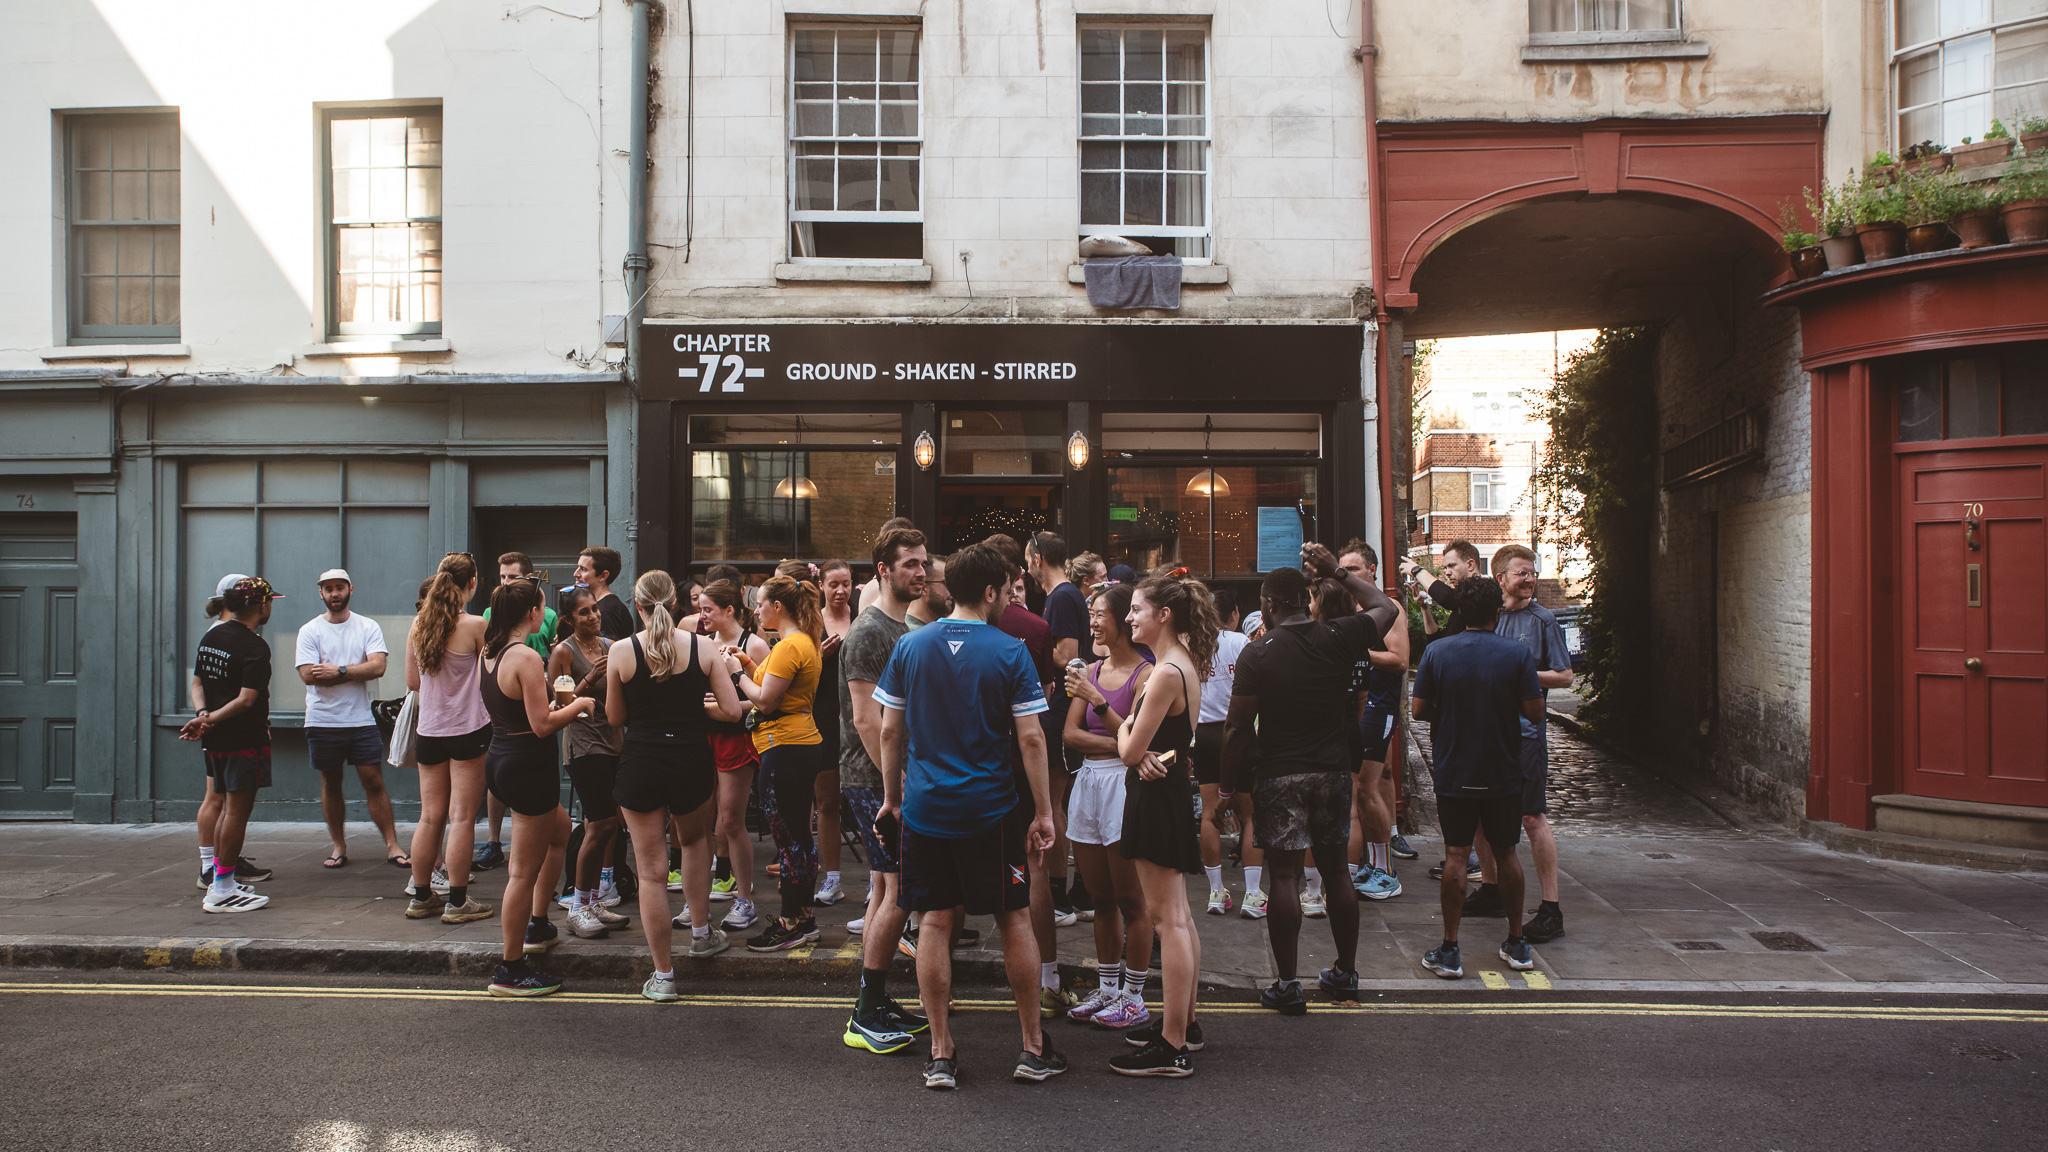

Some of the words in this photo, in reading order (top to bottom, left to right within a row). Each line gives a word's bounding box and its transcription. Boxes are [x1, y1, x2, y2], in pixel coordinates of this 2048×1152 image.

[672, 333, 771, 353] CHAPTER
[786, 362, 877, 381] GROUND
[894, 362, 975, 381] SHAKEN
[993, 362, 1077, 380] STIRRED
[16, 494, 35, 508] 74
[1963, 503, 1984, 518] 70
[534, 569, 551, 583] 74
